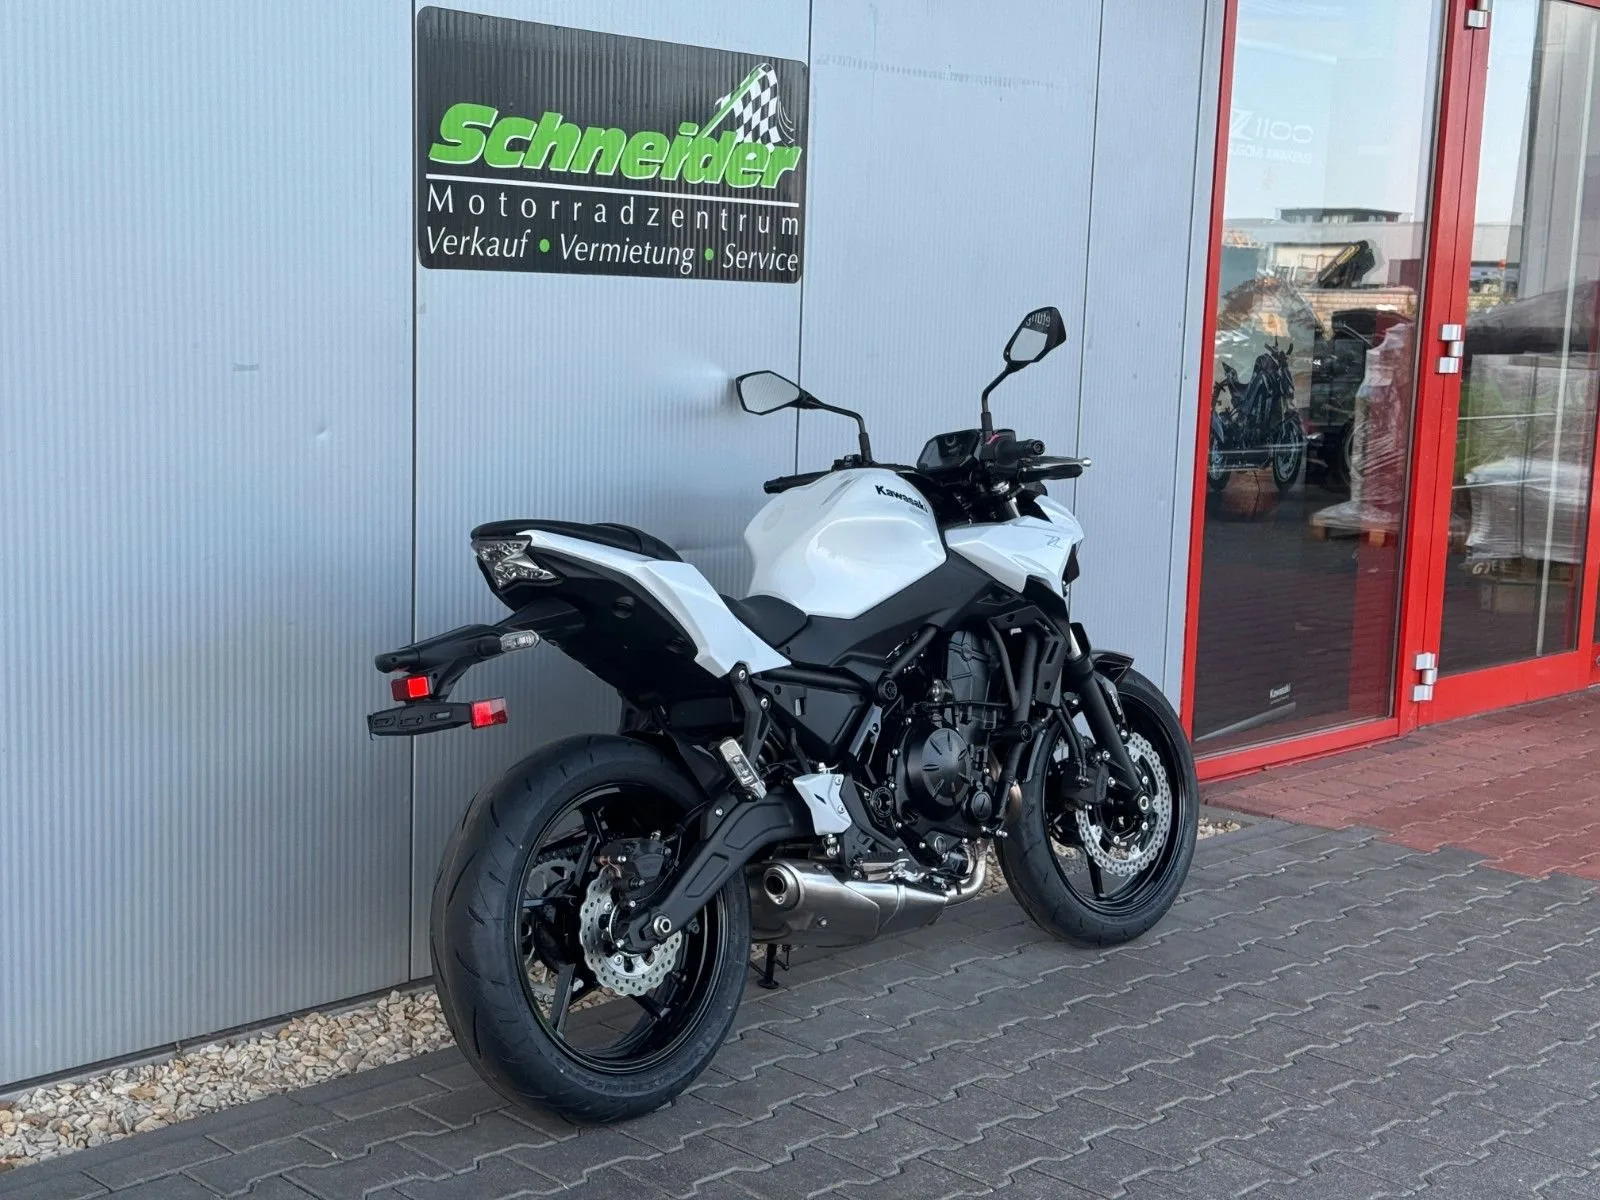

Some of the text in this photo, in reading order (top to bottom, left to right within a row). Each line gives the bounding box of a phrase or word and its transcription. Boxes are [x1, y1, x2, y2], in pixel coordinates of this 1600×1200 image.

[428, 102, 803, 190] Schneider
[427, 183, 799, 236] Motorradzentrum
[427, 226, 799, 275] Verkauf Vermietung Service
[874, 484, 929, 514] Kawasaki
